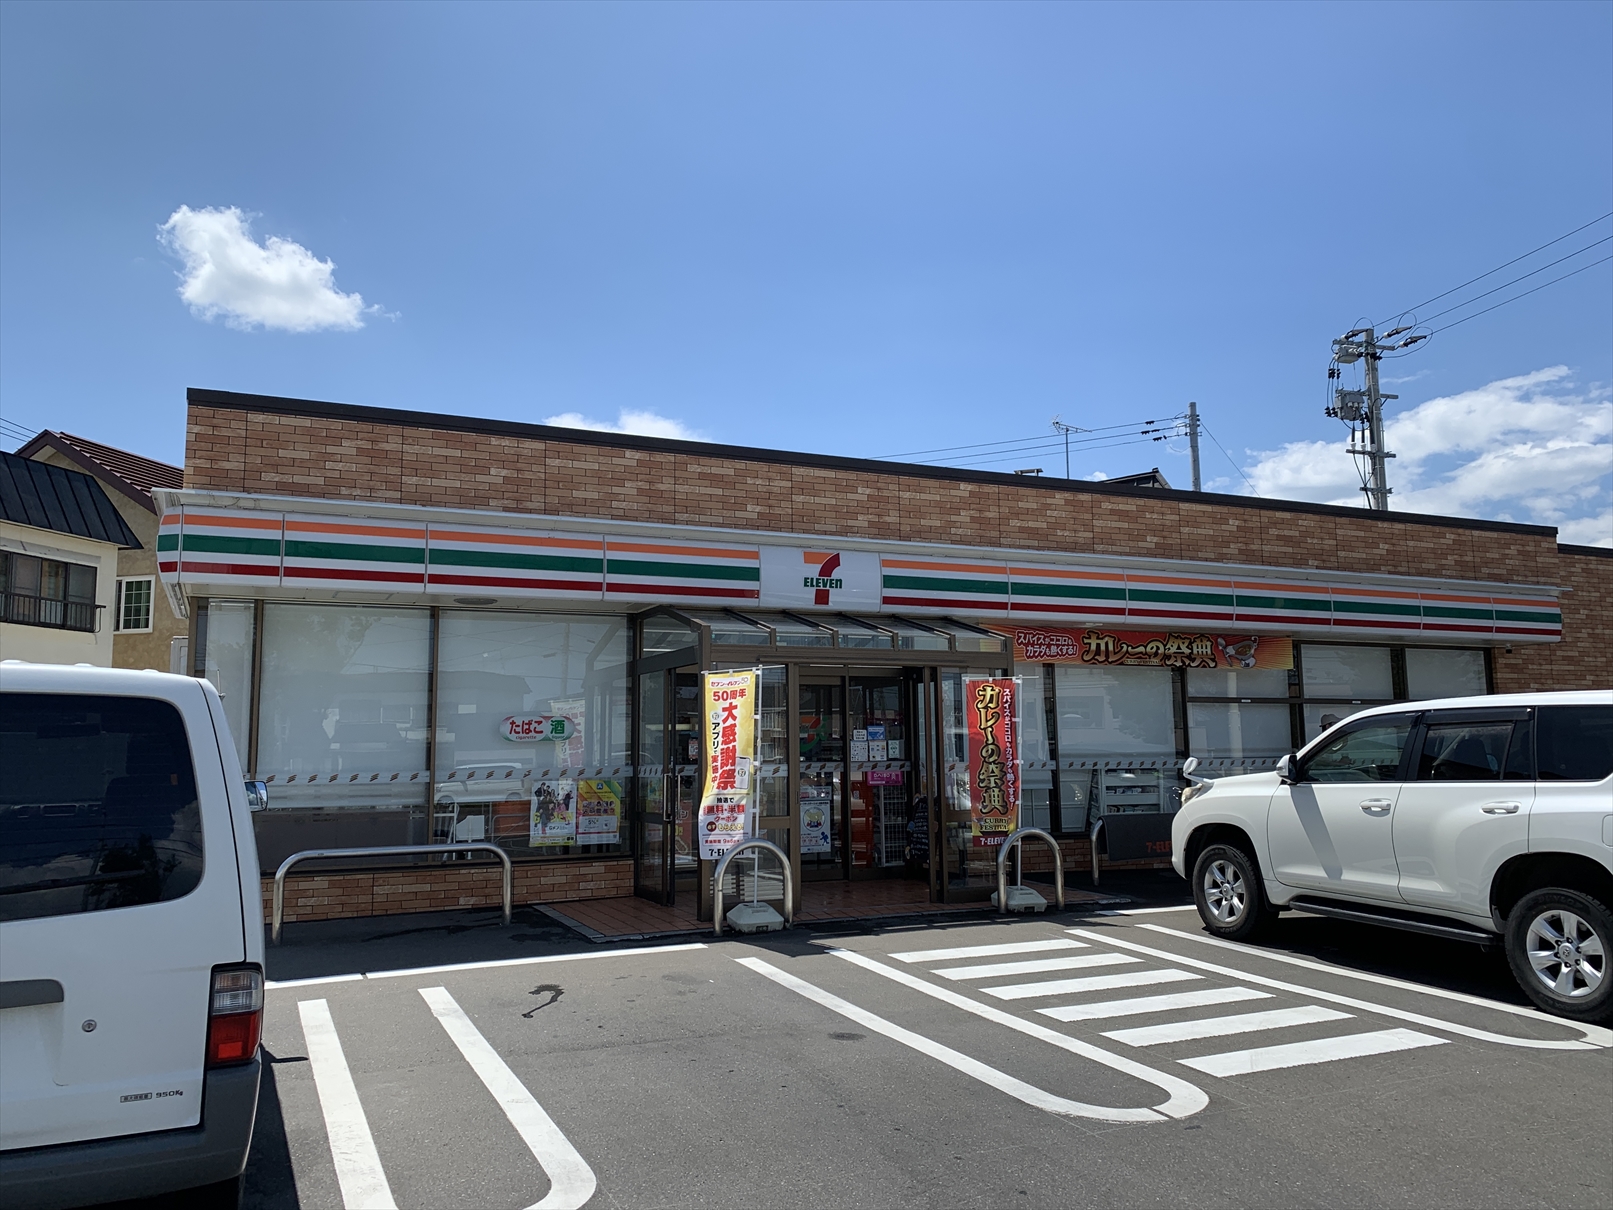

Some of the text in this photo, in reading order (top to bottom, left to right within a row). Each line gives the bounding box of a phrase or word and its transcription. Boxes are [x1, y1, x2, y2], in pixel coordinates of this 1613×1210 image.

[1082, 630, 1216, 667] カレーの祭典
[713, 688, 747, 702] 50周年
[509, 719, 565, 735] たばこ 酒
[716, 702, 738, 790] 大感謝祭
[976, 684, 1008, 814] カレーの祭典
[714, 815, 738, 823] クーポン
[980, 837, 1007, 846] 7-ELEVE
